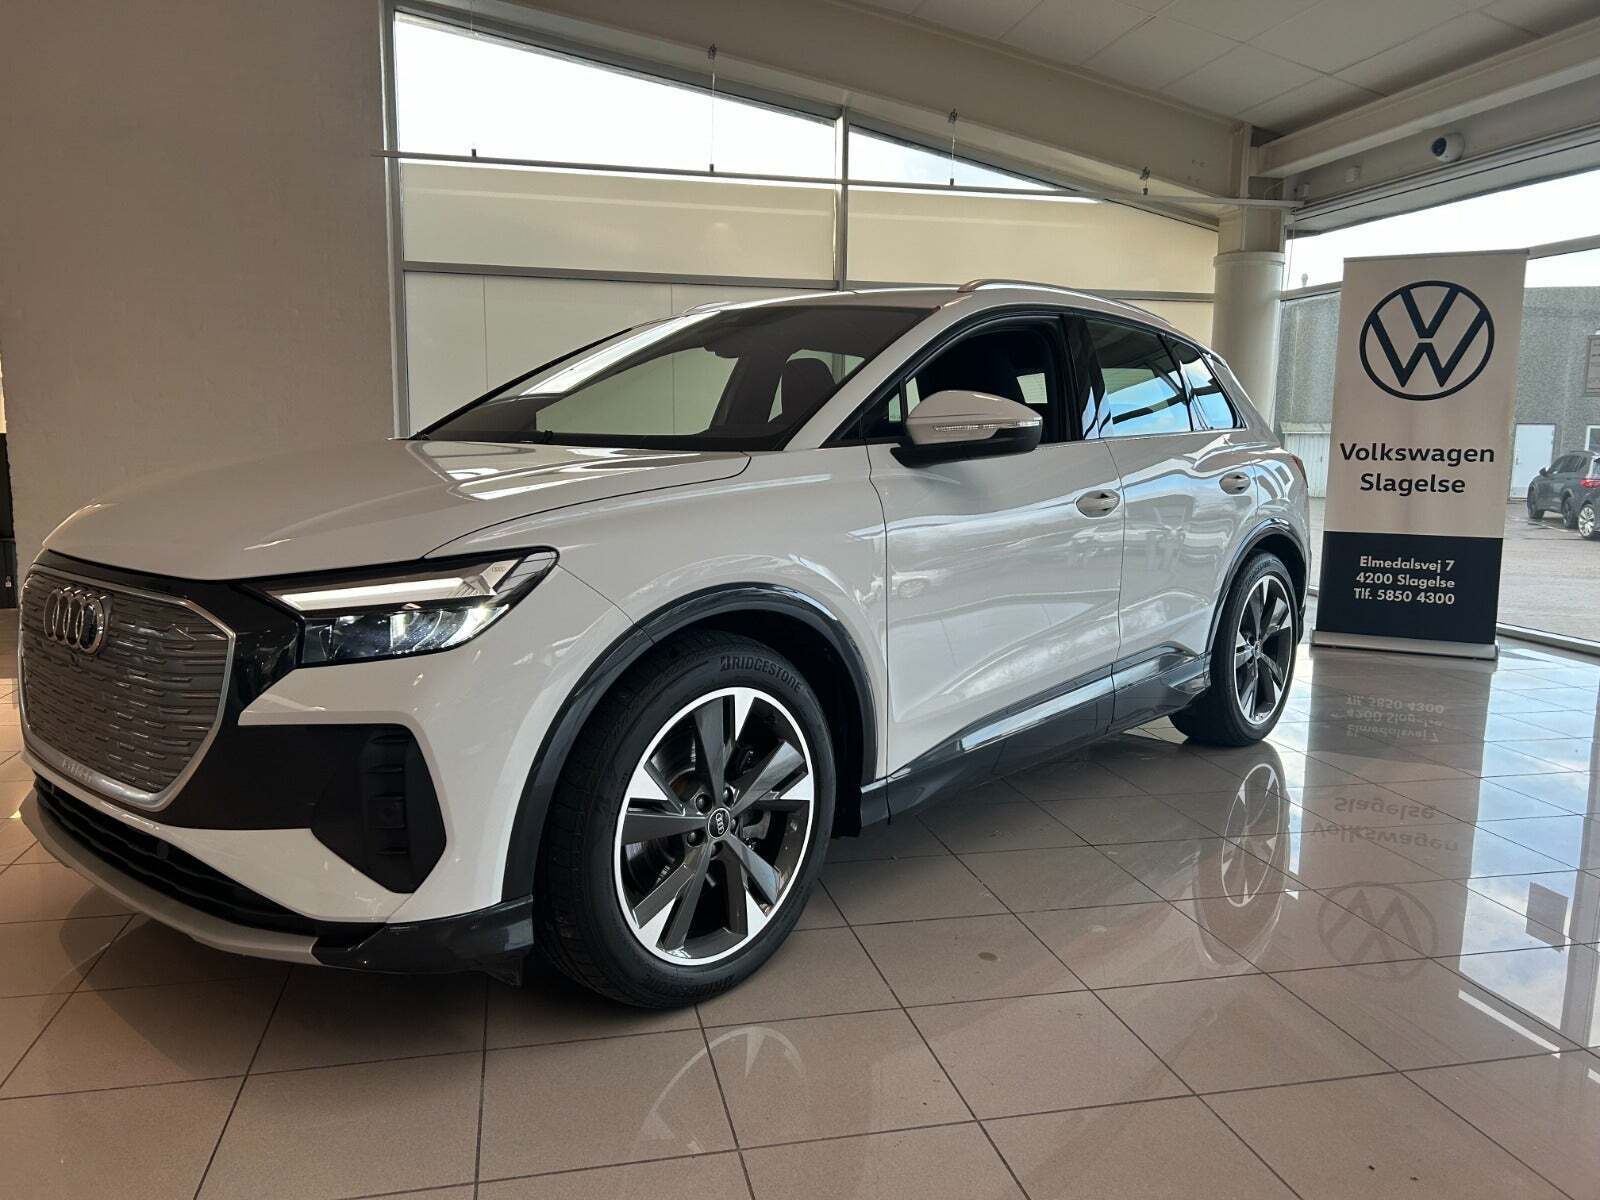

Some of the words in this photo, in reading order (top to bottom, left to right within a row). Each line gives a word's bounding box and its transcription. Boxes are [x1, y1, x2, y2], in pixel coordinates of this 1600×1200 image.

[1339, 442, 1495, 467] Volkswagen
[1360, 472, 1466, 497] Slagelse
[1359, 555, 1441, 573] Elmedalsvej
[1445, 559, 1455, 571] 7
[1356, 571, 1393, 584] 4200
[1397, 574, 1455, 589] Slagelse
[1353, 587, 1372, 600] Tlf.
[1376, 589, 1412, 602] 5850
[1416, 592, 1455, 605] 4300
[720, 655, 801, 693] BRIDGESTONE
